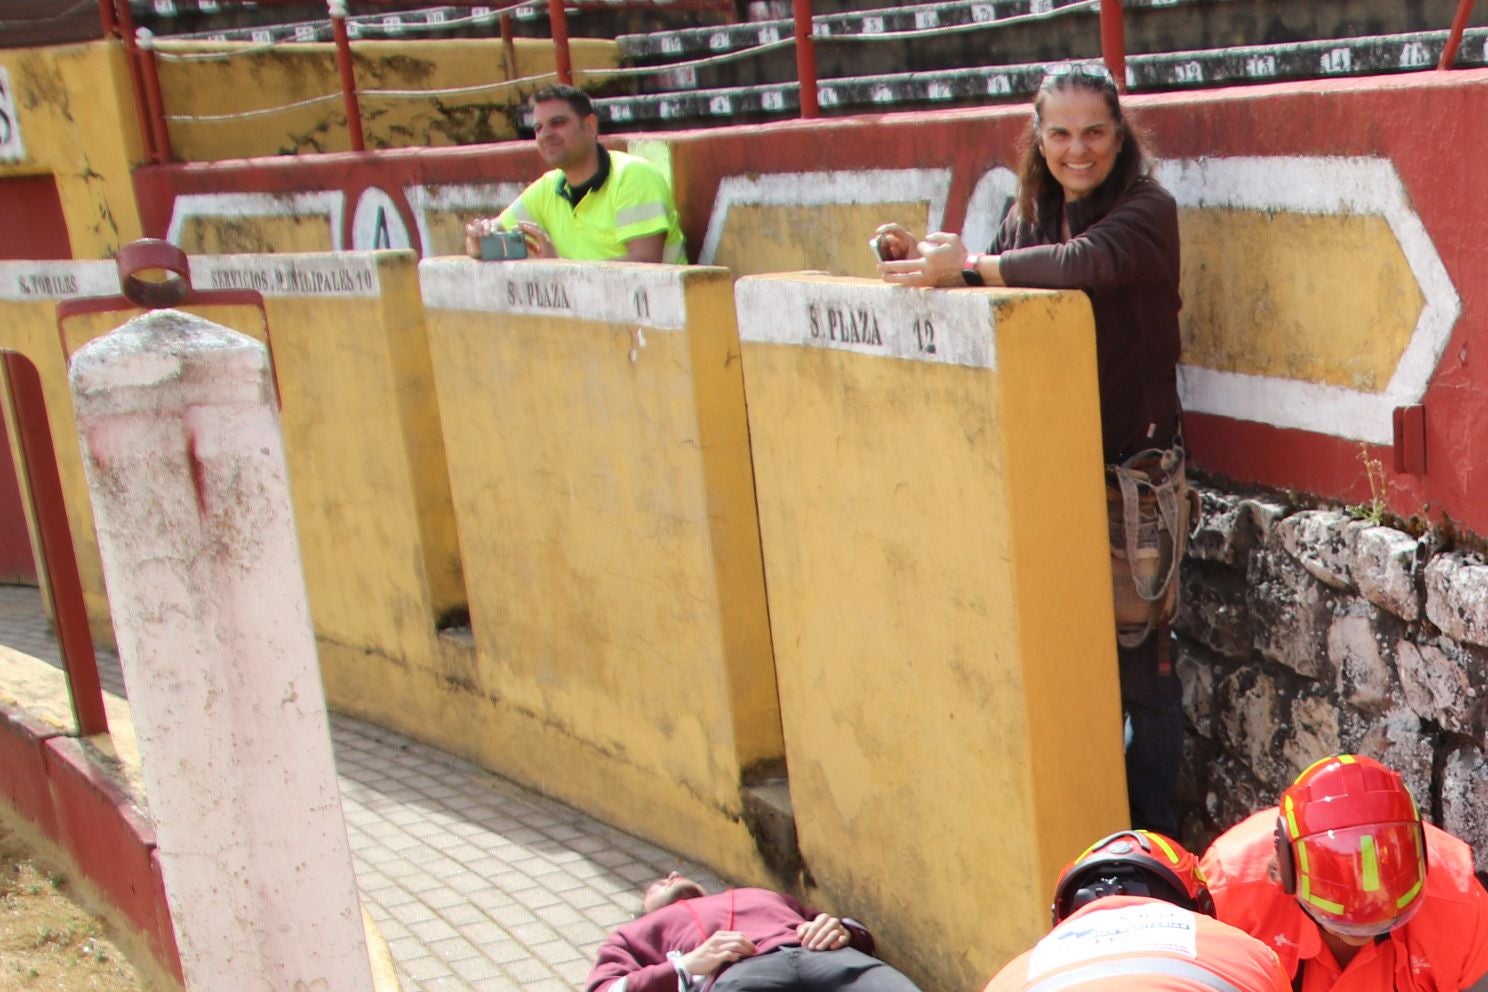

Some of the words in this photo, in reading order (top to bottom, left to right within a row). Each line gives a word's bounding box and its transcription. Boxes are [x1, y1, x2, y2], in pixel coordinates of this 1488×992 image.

[1328, 51, 1346, 70] 14
[356, 268, 373, 290] 10
[526, 281, 571, 309] PLAZA
[633, 286, 650, 318] 11
[827, 308, 883, 346] PLAZA
[913, 318, 936, 354] 12
